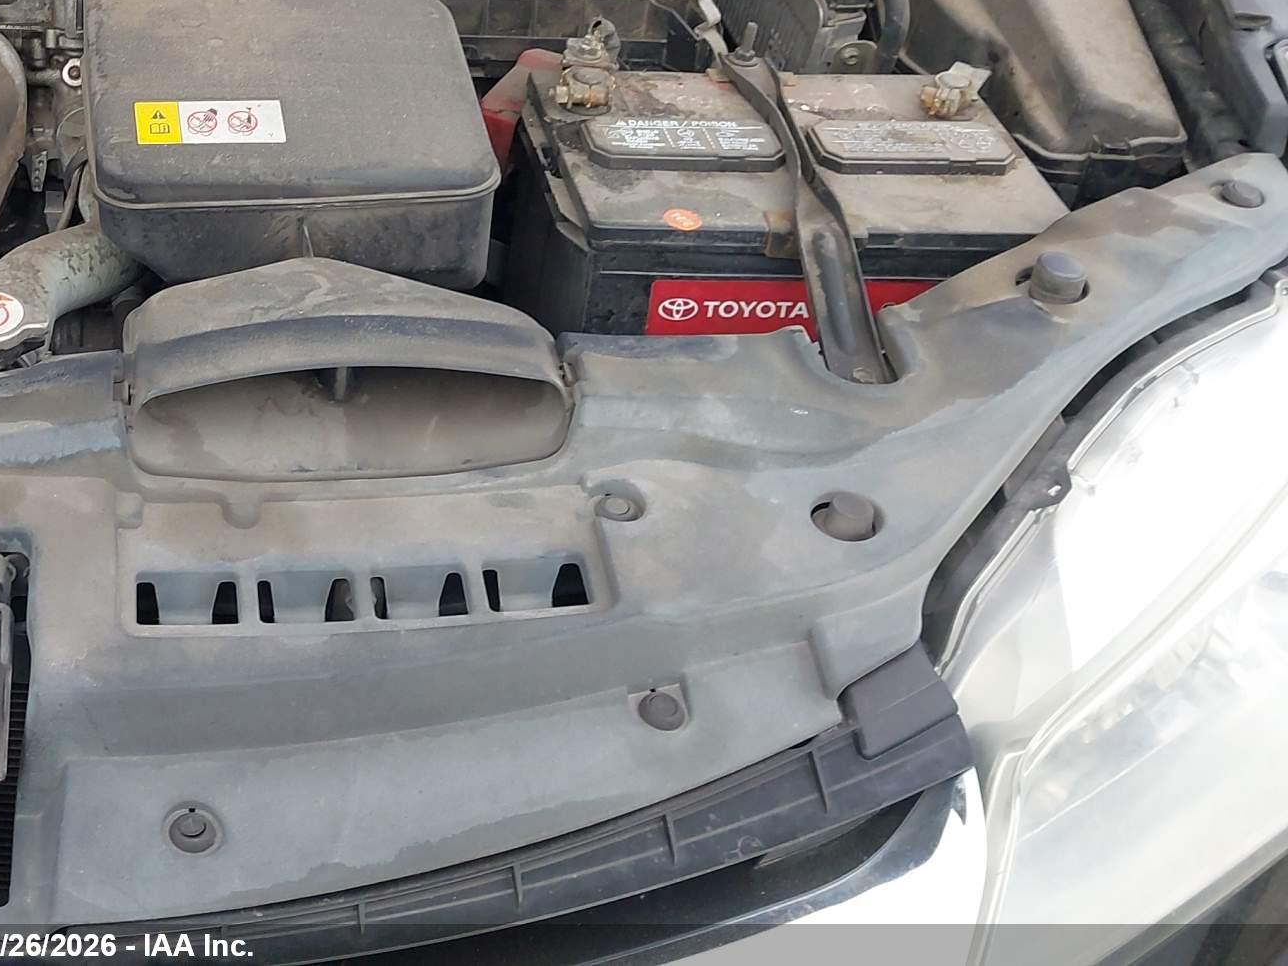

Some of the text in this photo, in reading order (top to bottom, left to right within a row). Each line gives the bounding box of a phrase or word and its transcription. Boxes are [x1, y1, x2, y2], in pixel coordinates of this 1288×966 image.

[628, 119, 678, 127] DANGER
[691, 120, 737, 128] POISON
[703, 300, 809, 319] TOYOTA
